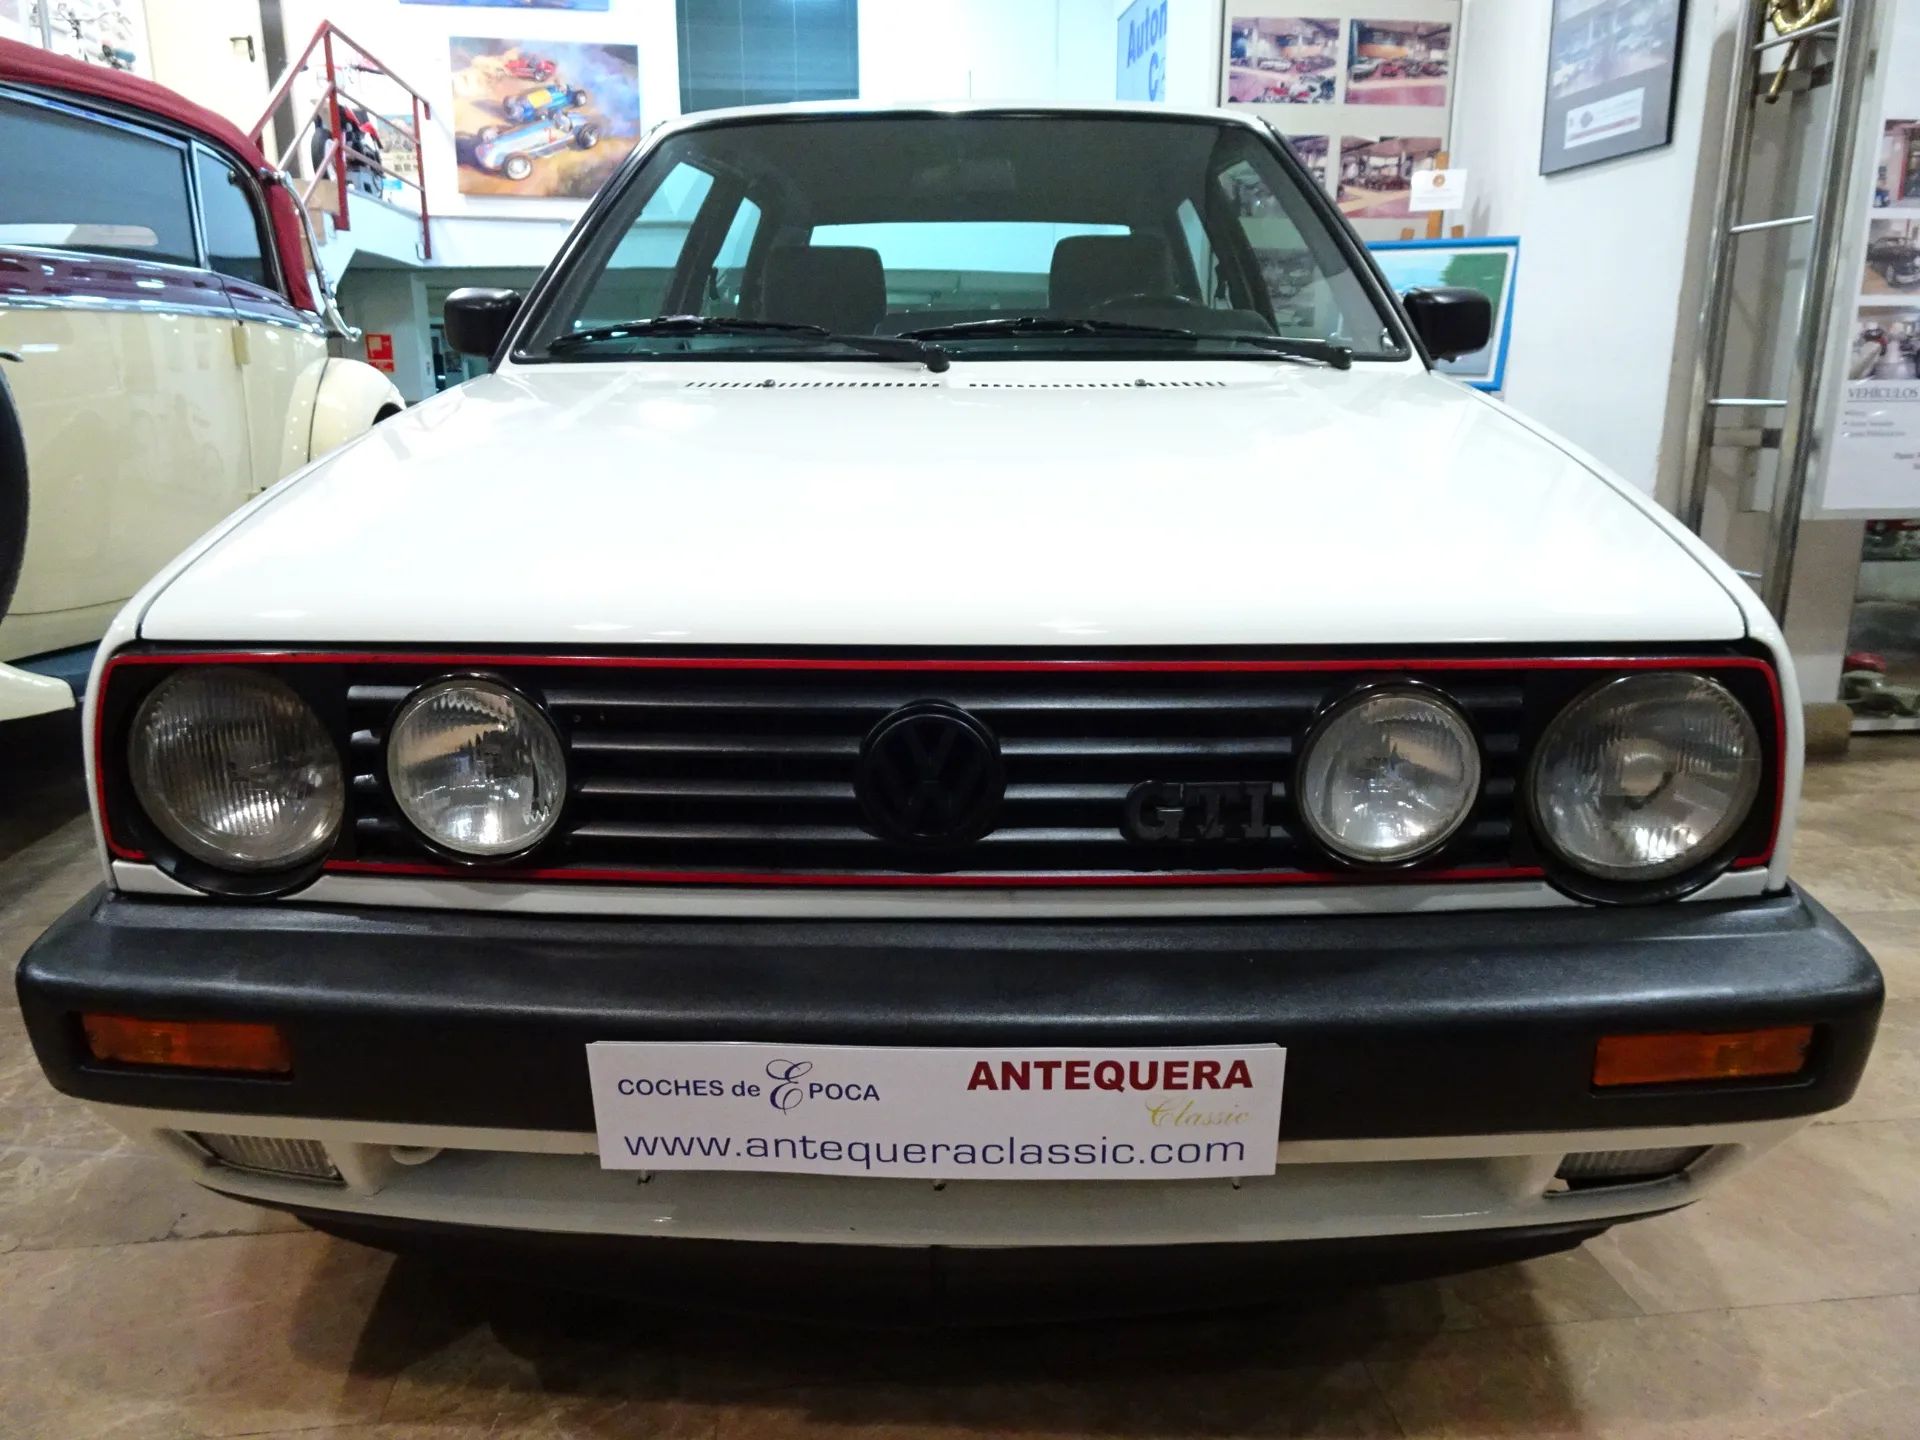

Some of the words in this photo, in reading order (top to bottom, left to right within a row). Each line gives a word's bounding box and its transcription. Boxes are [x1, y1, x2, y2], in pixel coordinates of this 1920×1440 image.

[1127, 779, 1272, 841] GTI
[618, 1079, 724, 1096] COCHES
[731, 1080, 761, 1097] de
[967, 1059, 1253, 1093] ANTEQUERA
[1145, 1097, 1249, 1127] Classic
[624, 1134, 1244, 1170] www.antequeraclassic.com
